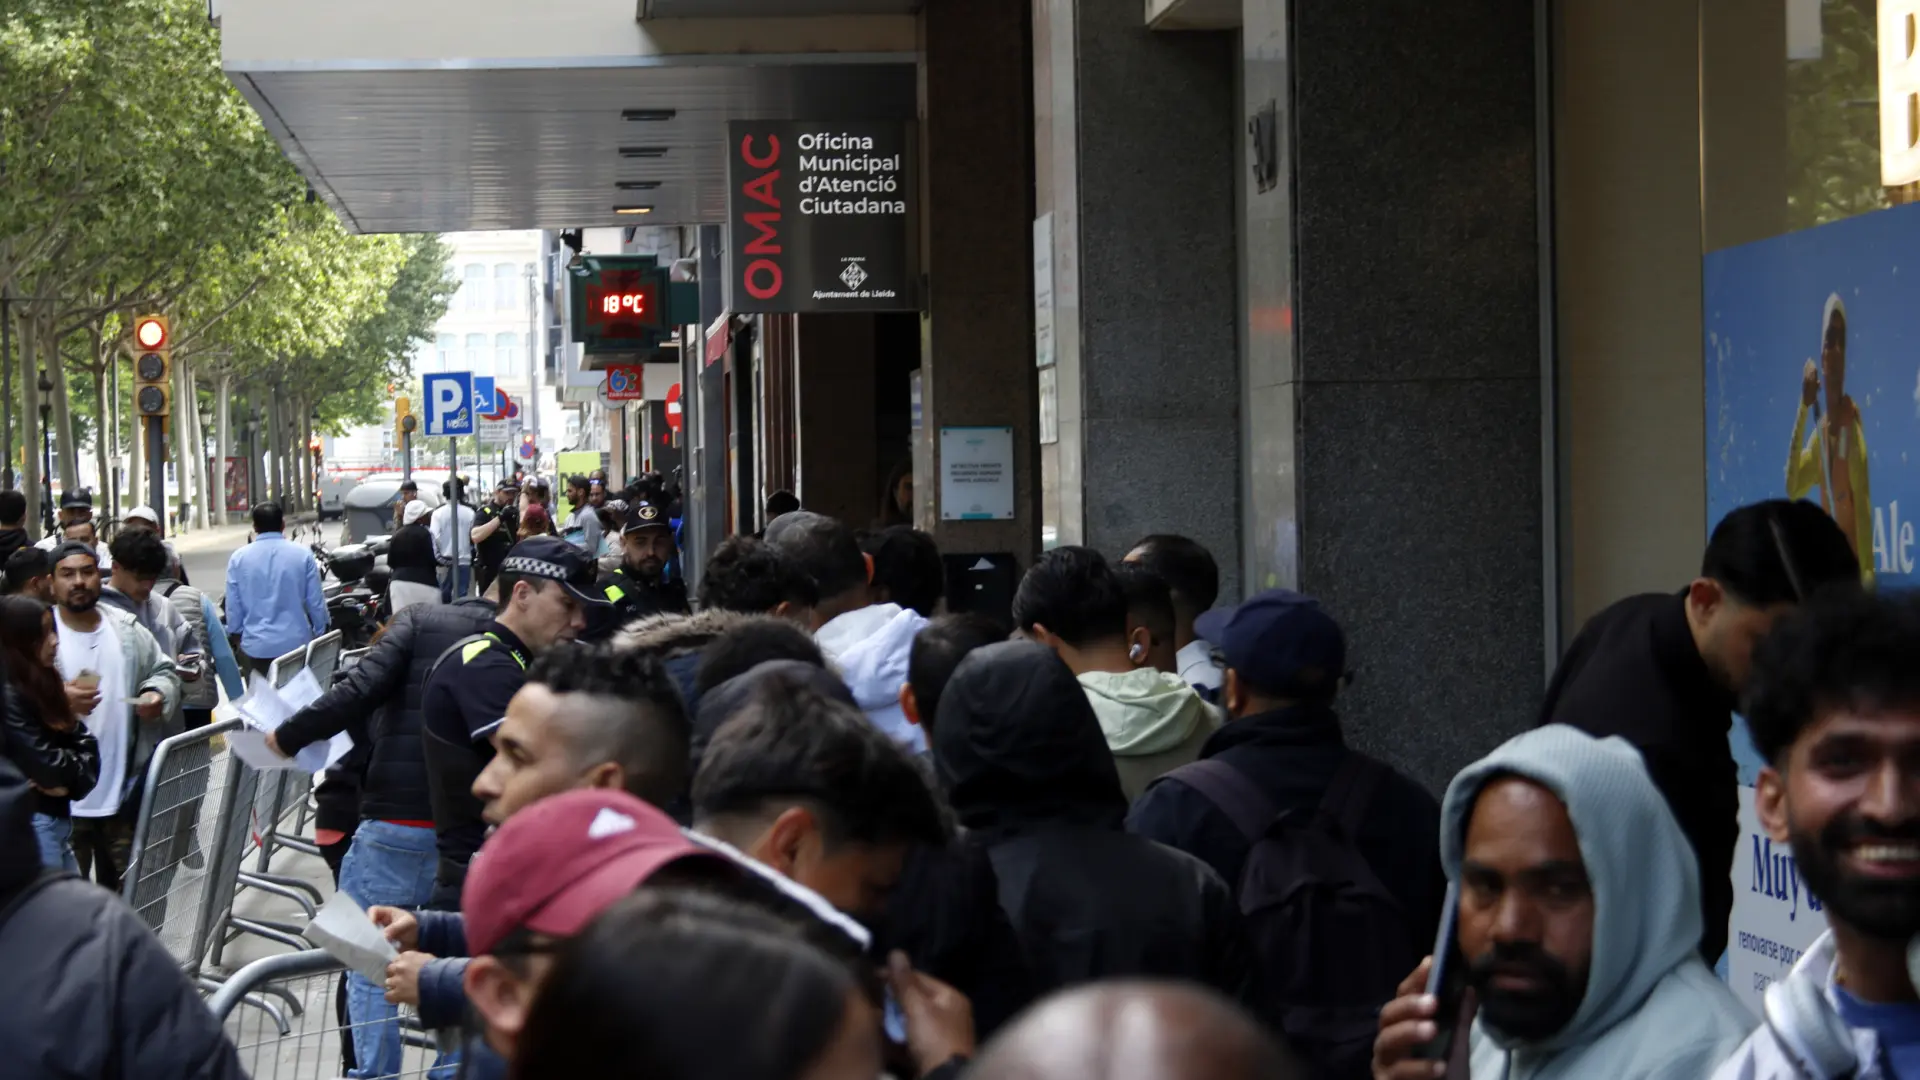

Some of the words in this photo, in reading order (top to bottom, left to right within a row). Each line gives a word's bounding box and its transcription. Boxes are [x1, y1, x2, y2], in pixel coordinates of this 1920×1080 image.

[798, 132, 873, 150] Oficina
[799, 154, 900, 174] Municipal
[741, 134, 783, 299] OMAC
[799, 198, 906, 214] Ciutadana
[812, 290, 859, 299] Ajuntament
[860, 290, 870, 298] de
[871, 290, 896, 298] Lleida
[430, 378, 463, 434] P
[1872, 500, 1915, 574] Ale
[1751, 833, 1800, 922] Muy
[1739, 930, 1778, 960] renovarse
[1780, 945, 1794, 968] por
